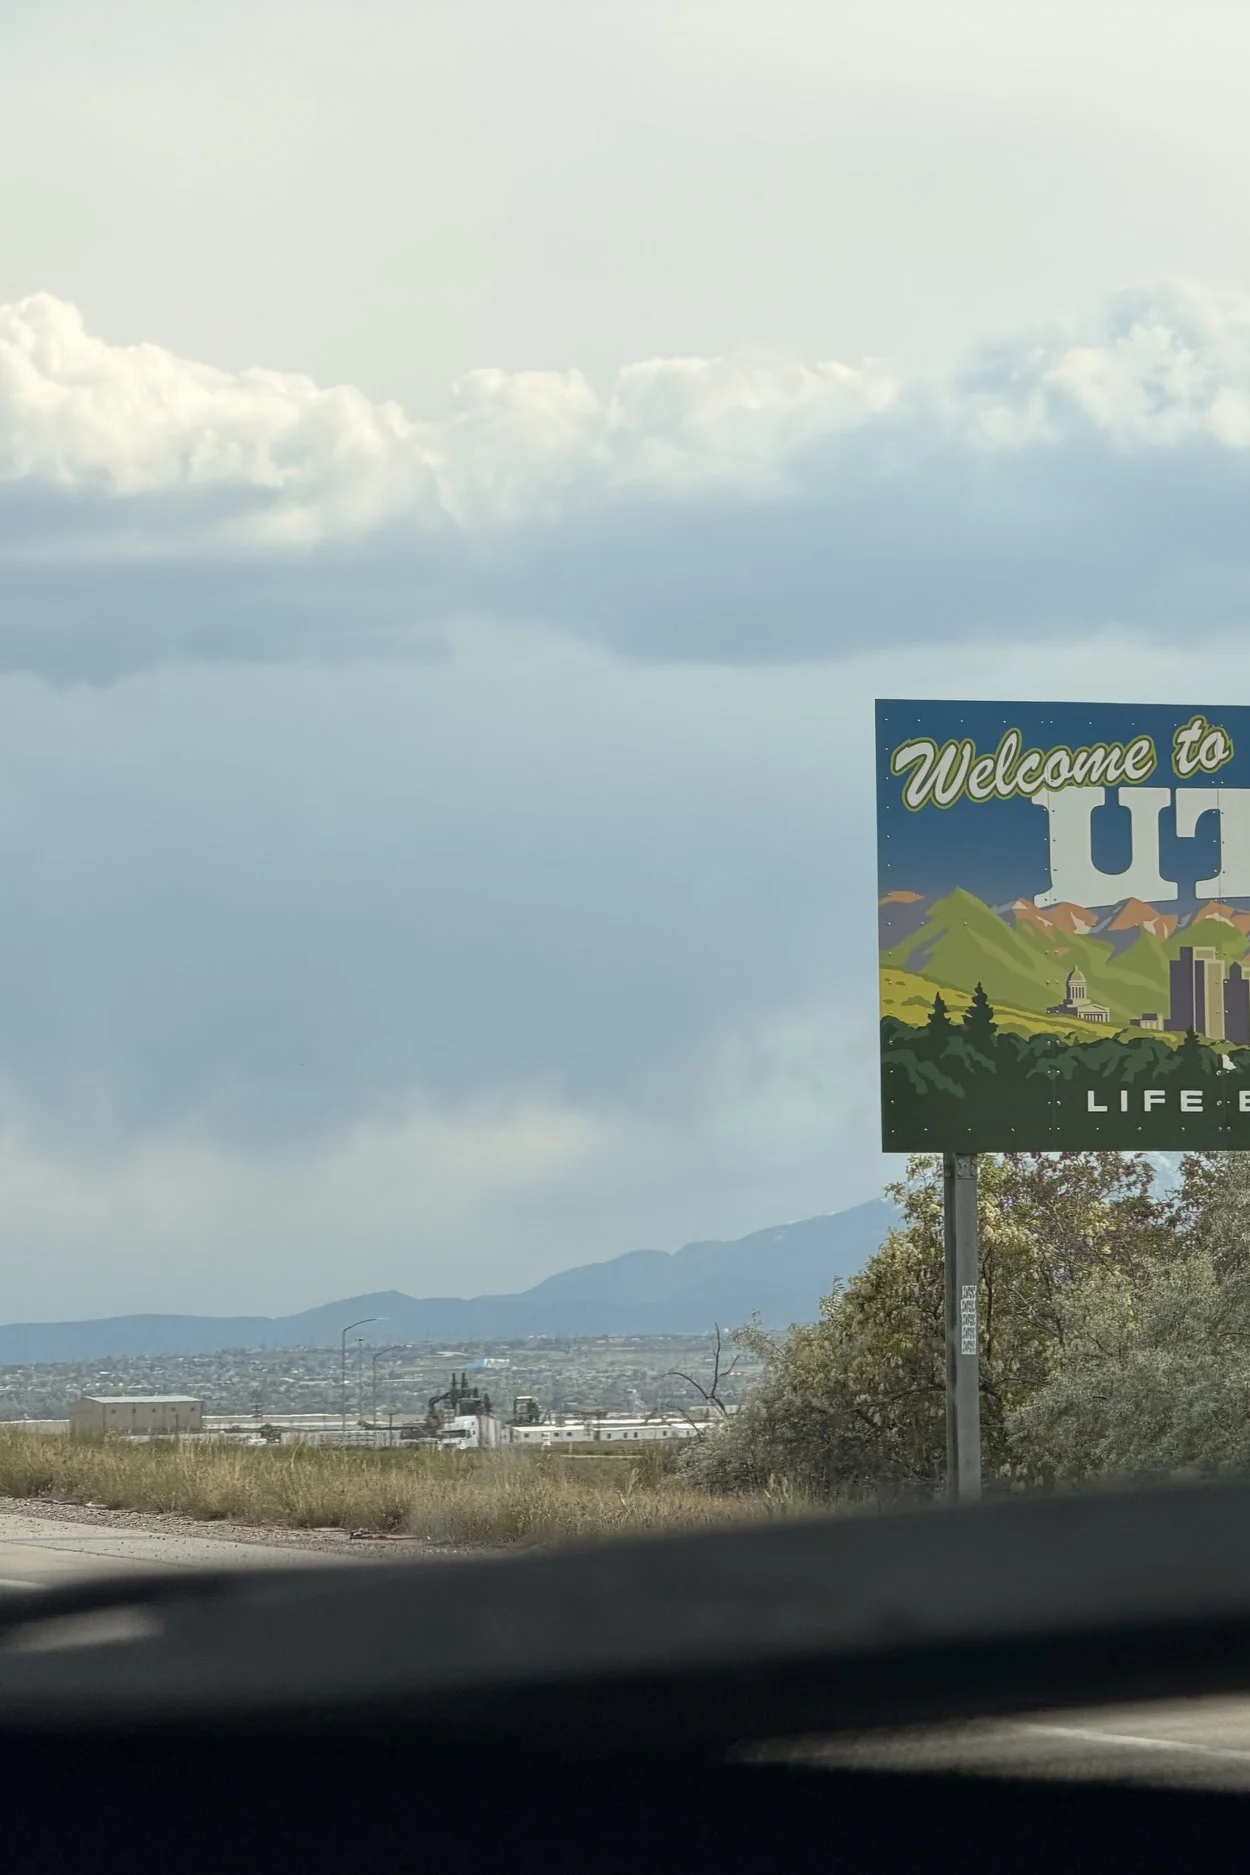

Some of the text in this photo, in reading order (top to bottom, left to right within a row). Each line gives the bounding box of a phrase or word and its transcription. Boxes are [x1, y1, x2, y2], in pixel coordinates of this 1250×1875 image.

[893, 717, 1232, 809] Welcome to
[1087, 1090, 1203, 1112] LIFE
